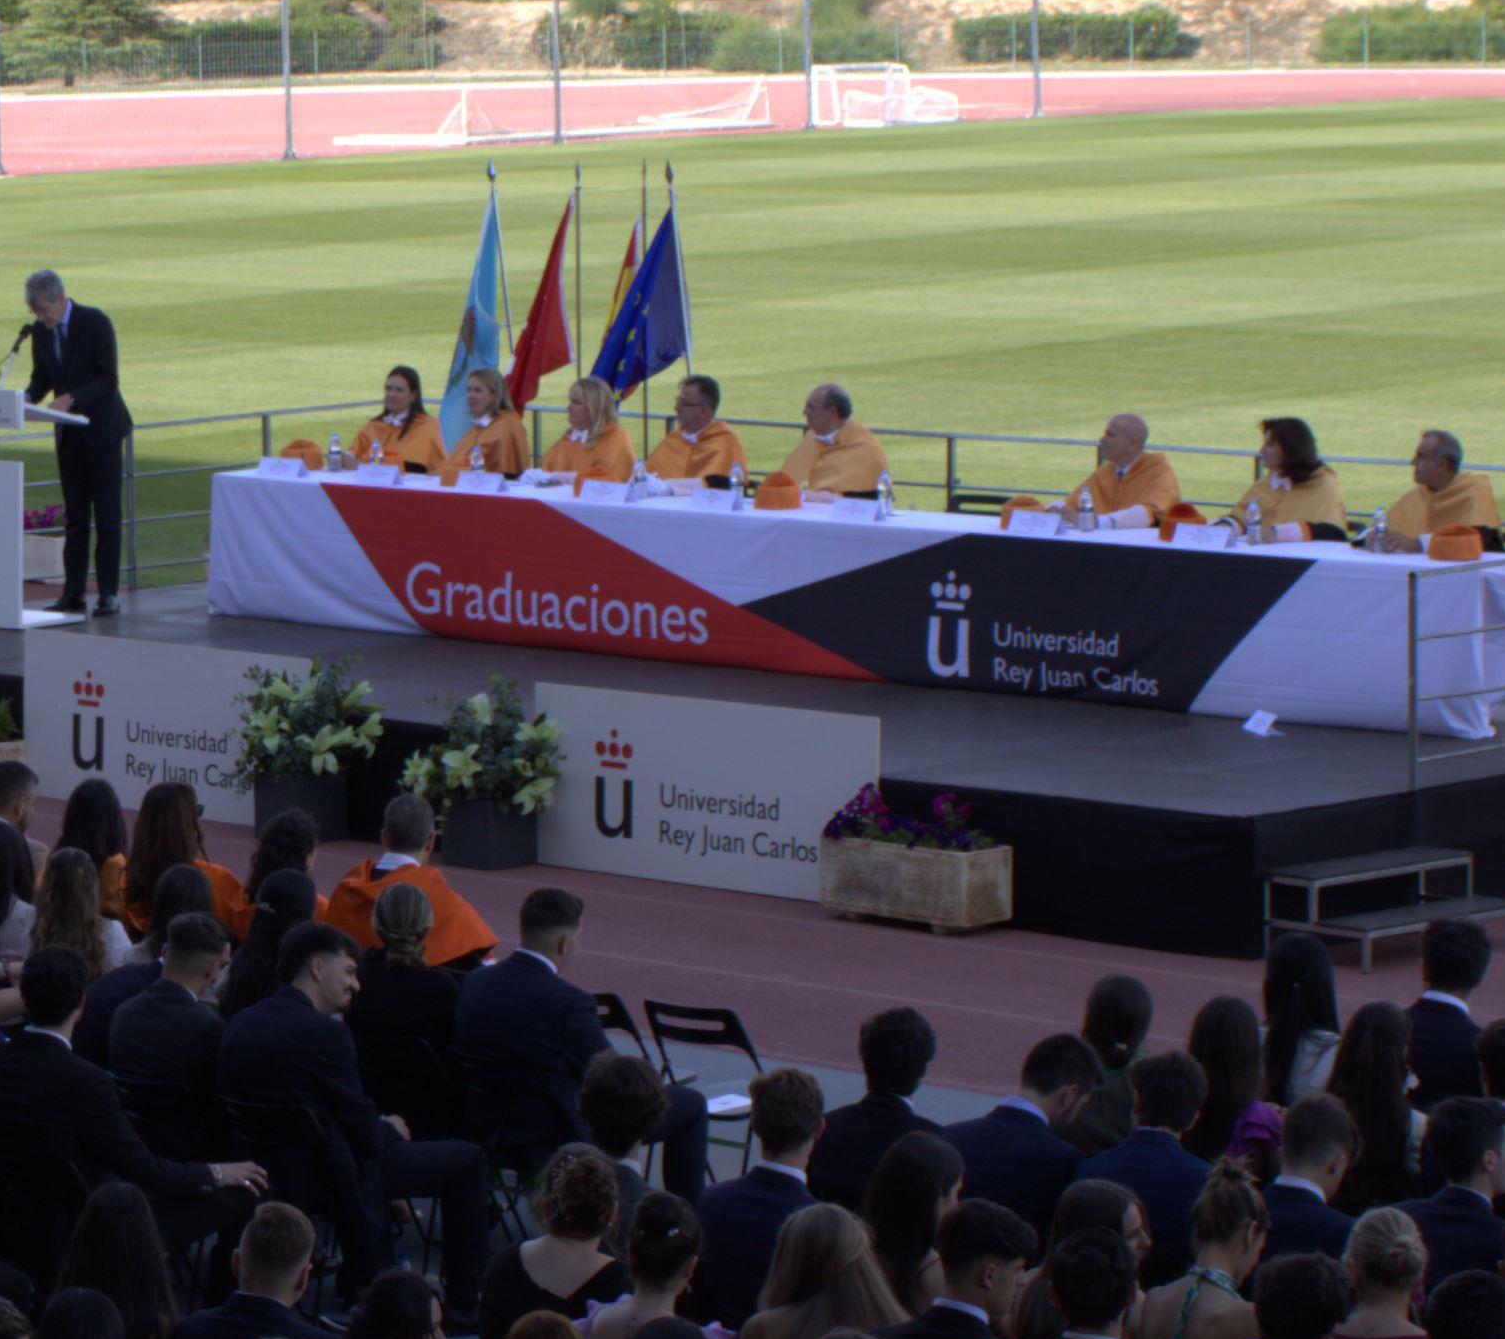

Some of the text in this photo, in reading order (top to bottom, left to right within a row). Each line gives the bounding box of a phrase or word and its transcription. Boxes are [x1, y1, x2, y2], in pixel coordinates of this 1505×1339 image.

[404, 560, 709, 646] Graduaciones
[992, 621, 1120, 658] Universidad
[992, 656, 1159, 696] Rey Juan Carlos
[125, 719, 229, 755] Universidad
[124, 753, 157, 785] Rey
[161, 757, 199, 784] Juan
[658, 783, 780, 822] Universidad
[658, 819, 819, 863] Rey Juan Carlos
